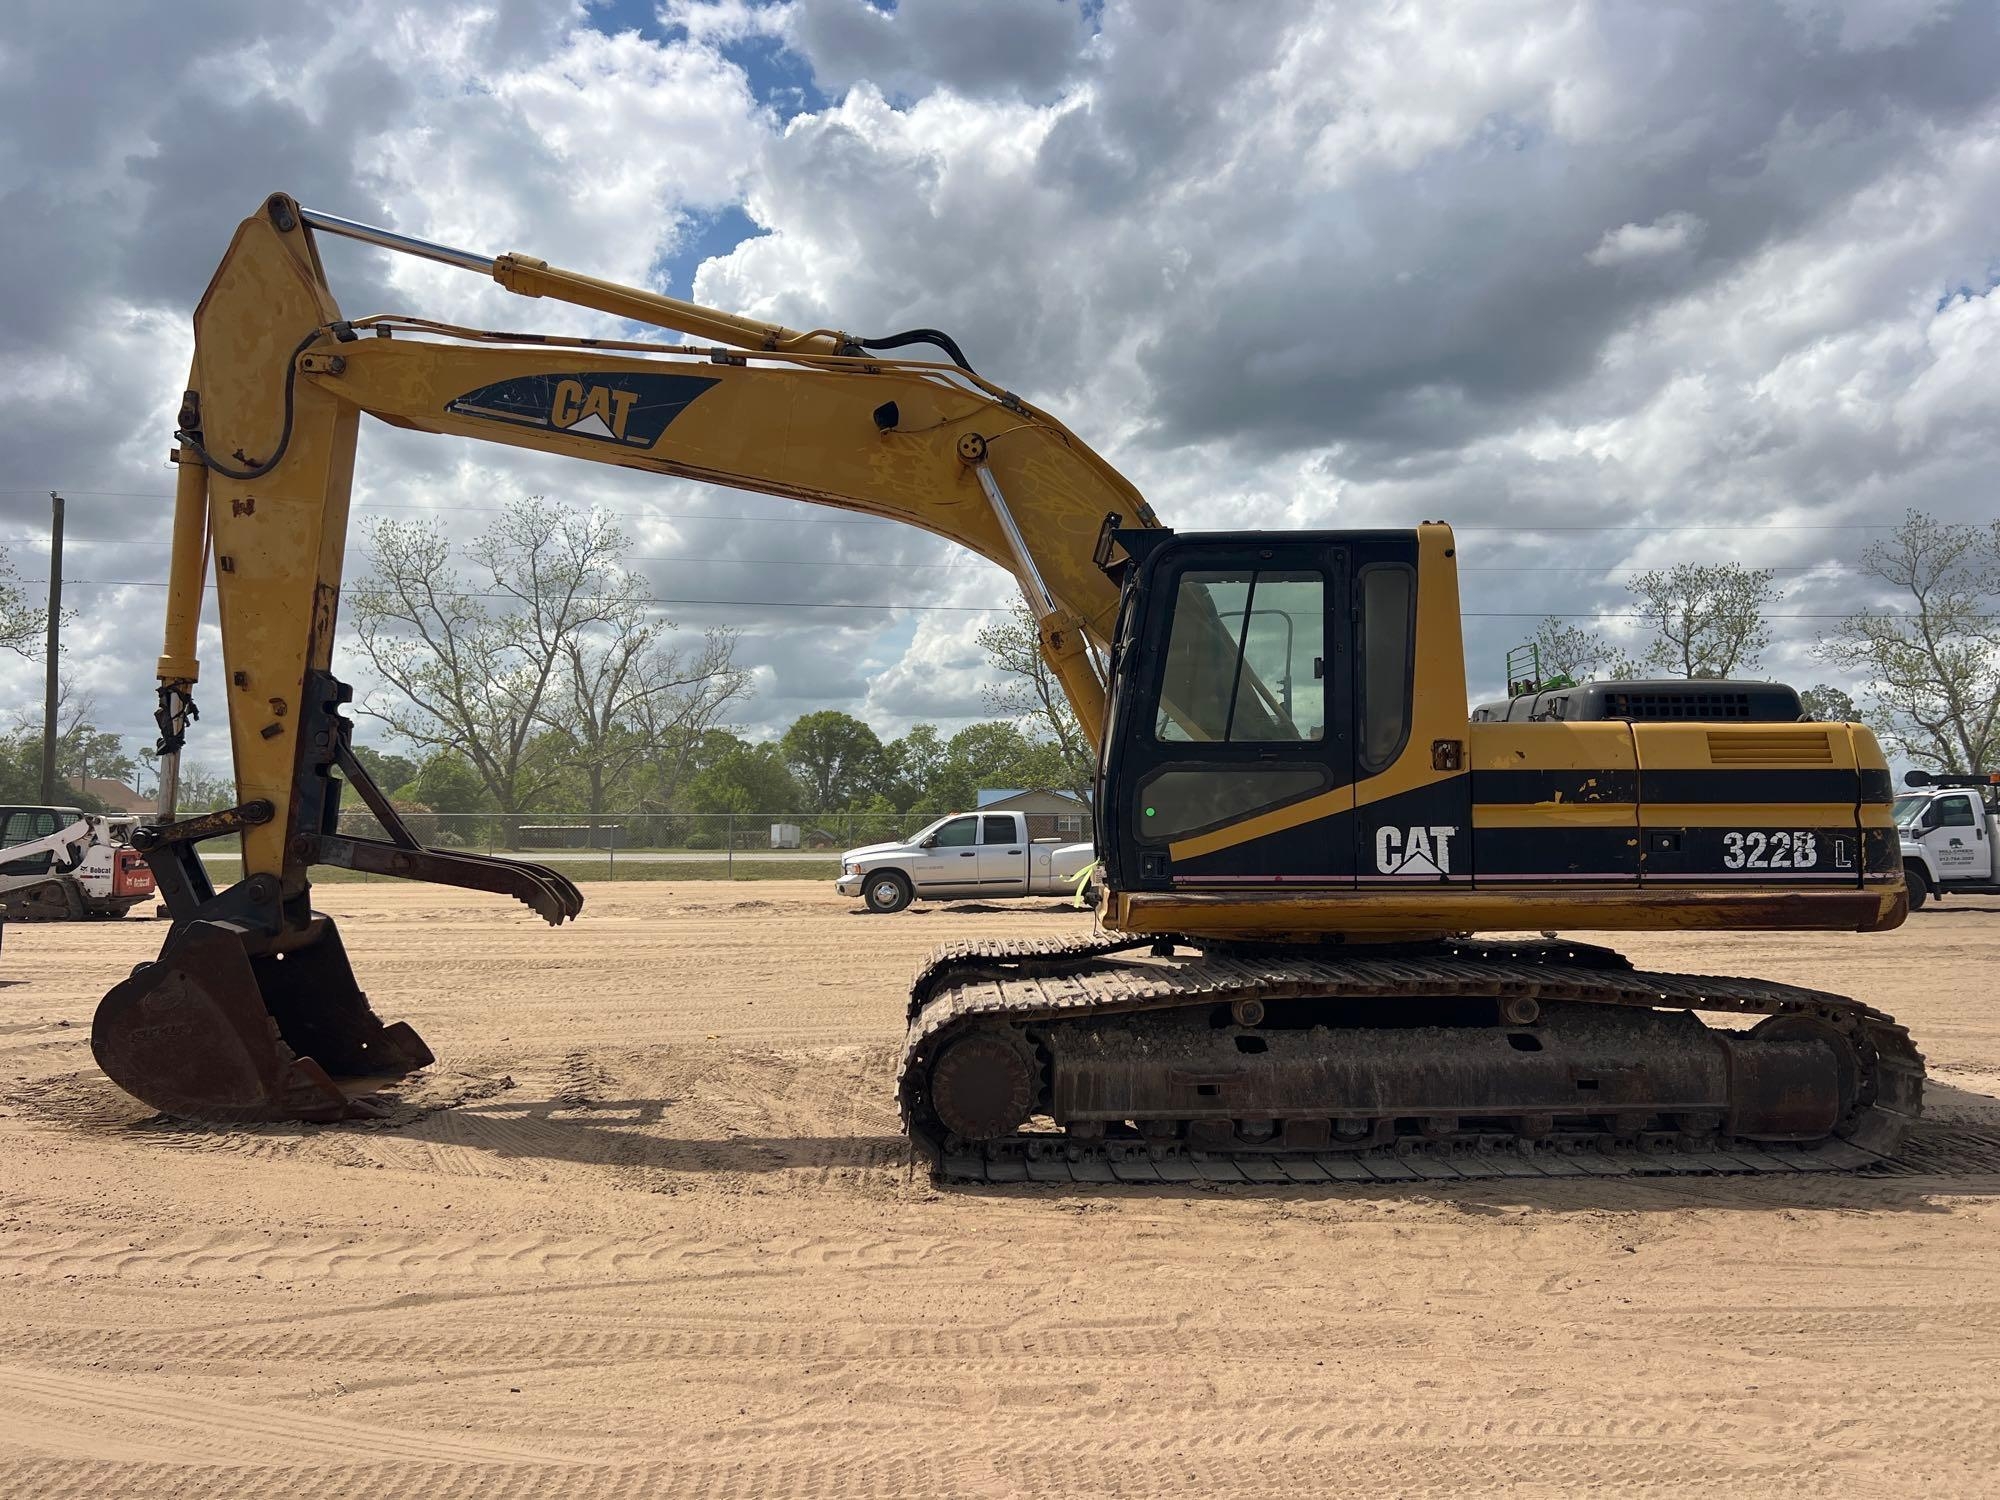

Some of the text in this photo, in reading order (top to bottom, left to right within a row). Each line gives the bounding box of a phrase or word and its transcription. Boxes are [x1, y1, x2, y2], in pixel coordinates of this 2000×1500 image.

[552, 379, 638, 440] CAT
[1376, 826, 1455, 874] CAT
[1723, 831, 1851, 869] 322B L
